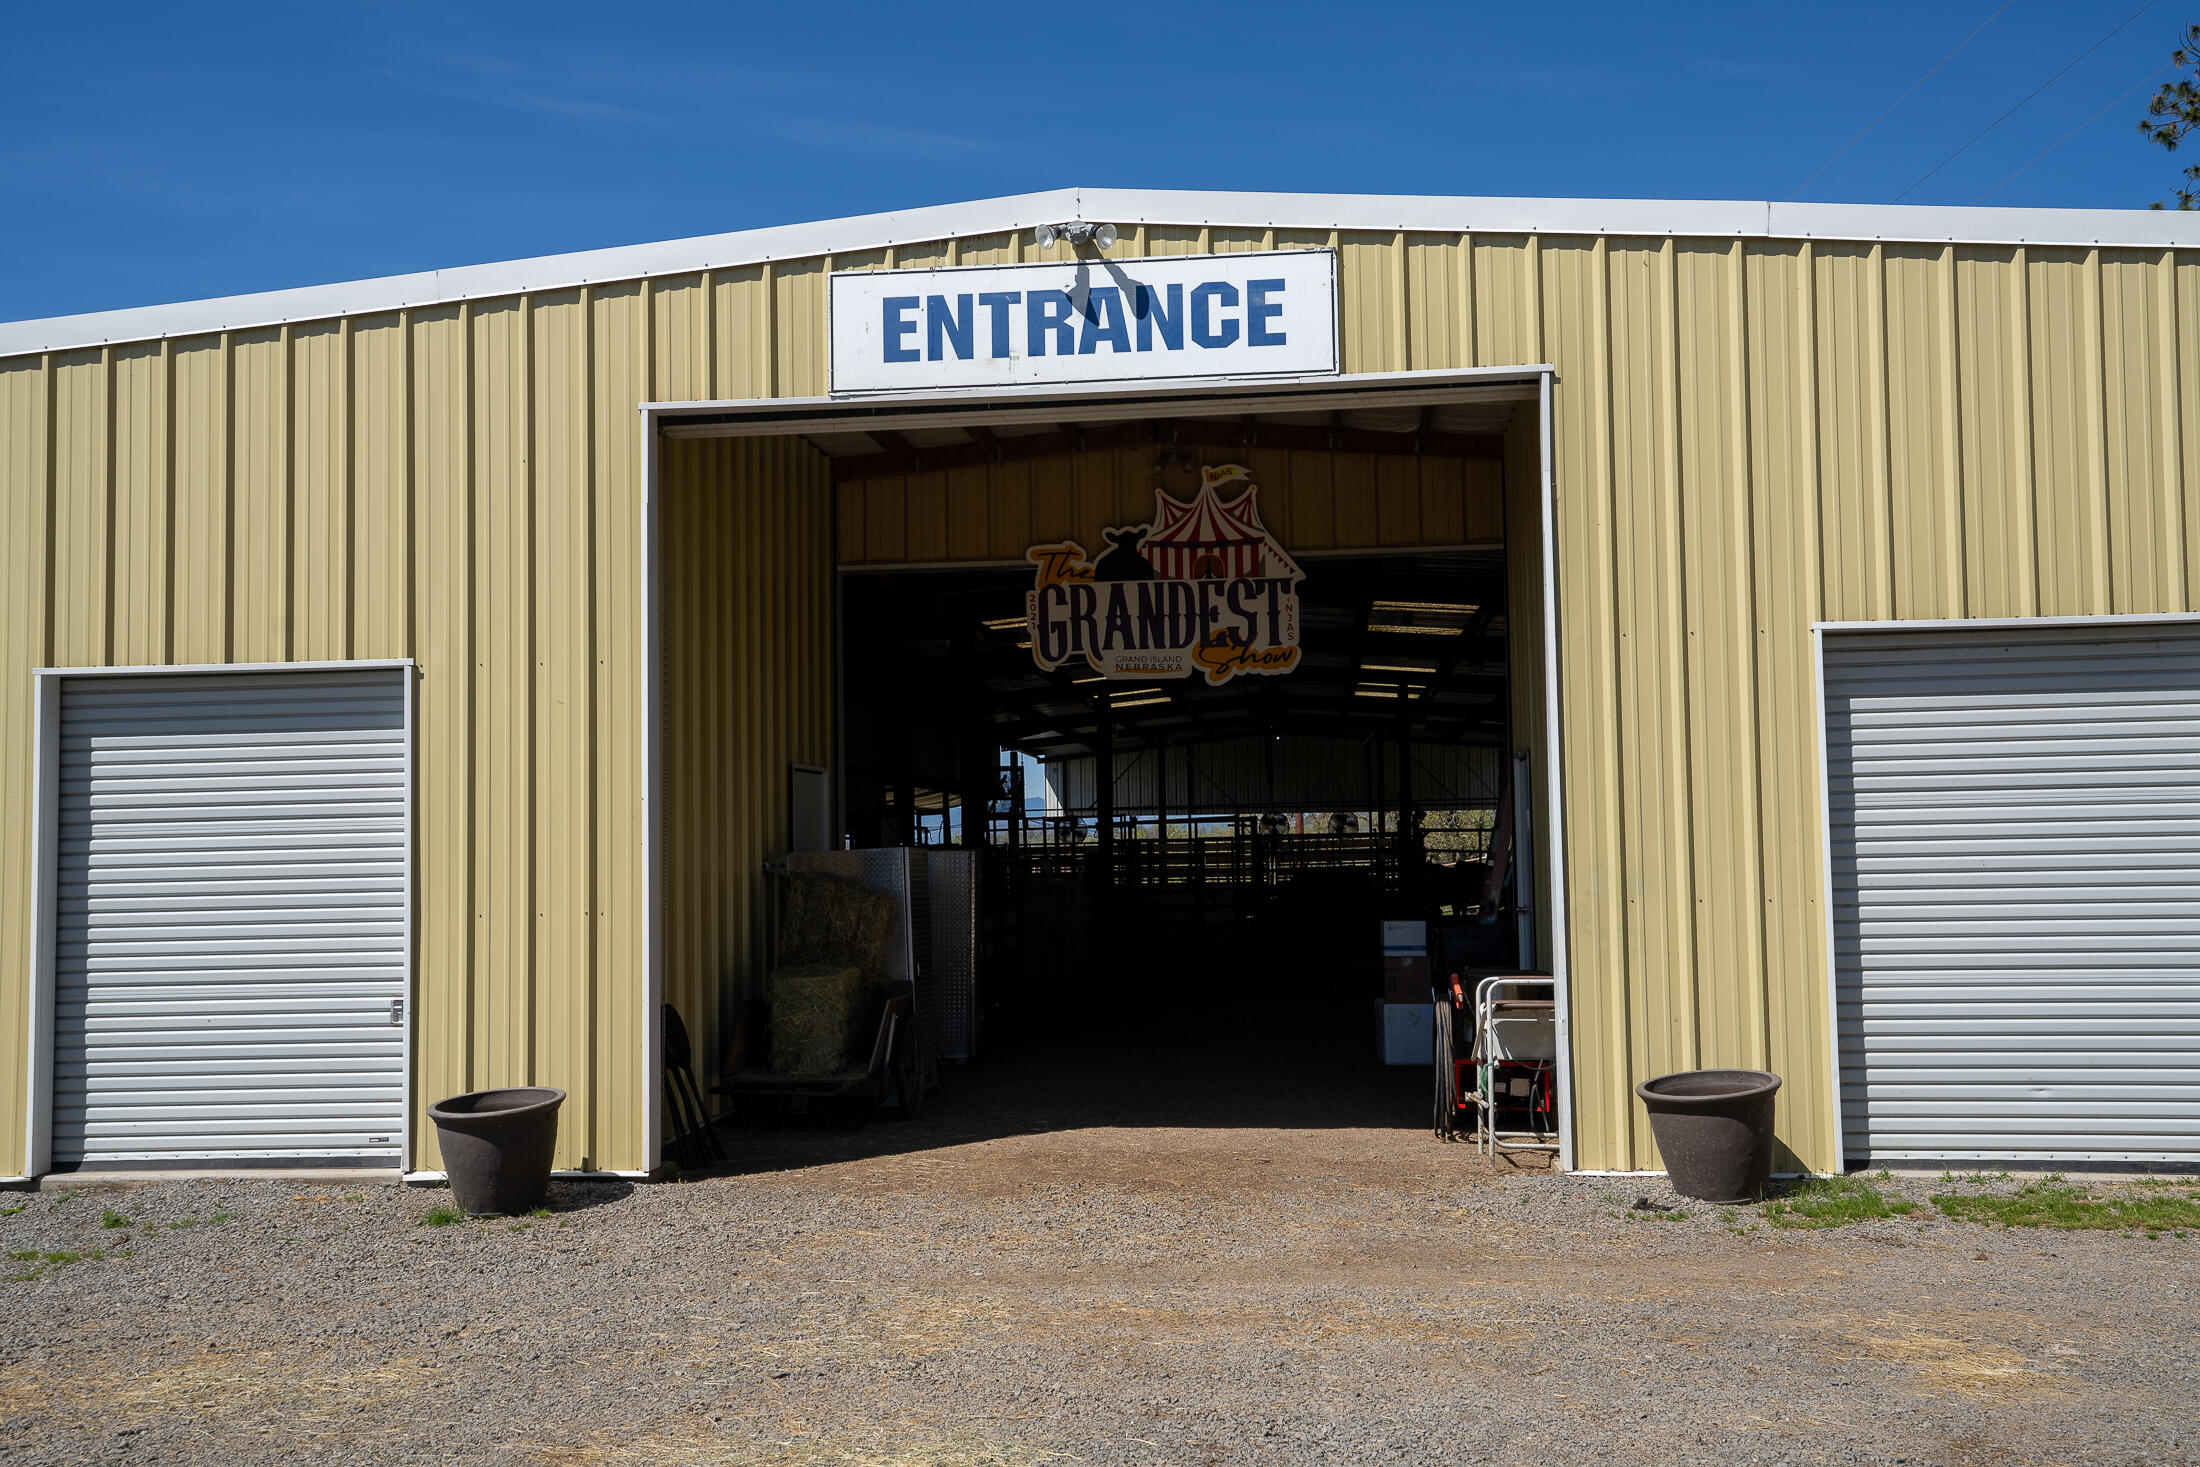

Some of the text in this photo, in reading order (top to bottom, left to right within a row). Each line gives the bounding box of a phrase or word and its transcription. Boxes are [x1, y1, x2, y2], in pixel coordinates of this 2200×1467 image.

[882, 278, 1287, 363] ENTRANCE
[1038, 549, 1096, 582] The
[1029, 594, 1037, 630] 2021
[1036, 578, 1293, 663] GRANDEST
[1285, 604, 1295, 641] NJAS
[1115, 655, 1183, 663] GRAND ISLAND
[1115, 663, 1183, 671] NEBRASKA
[1198, 637, 1293, 674] Show
